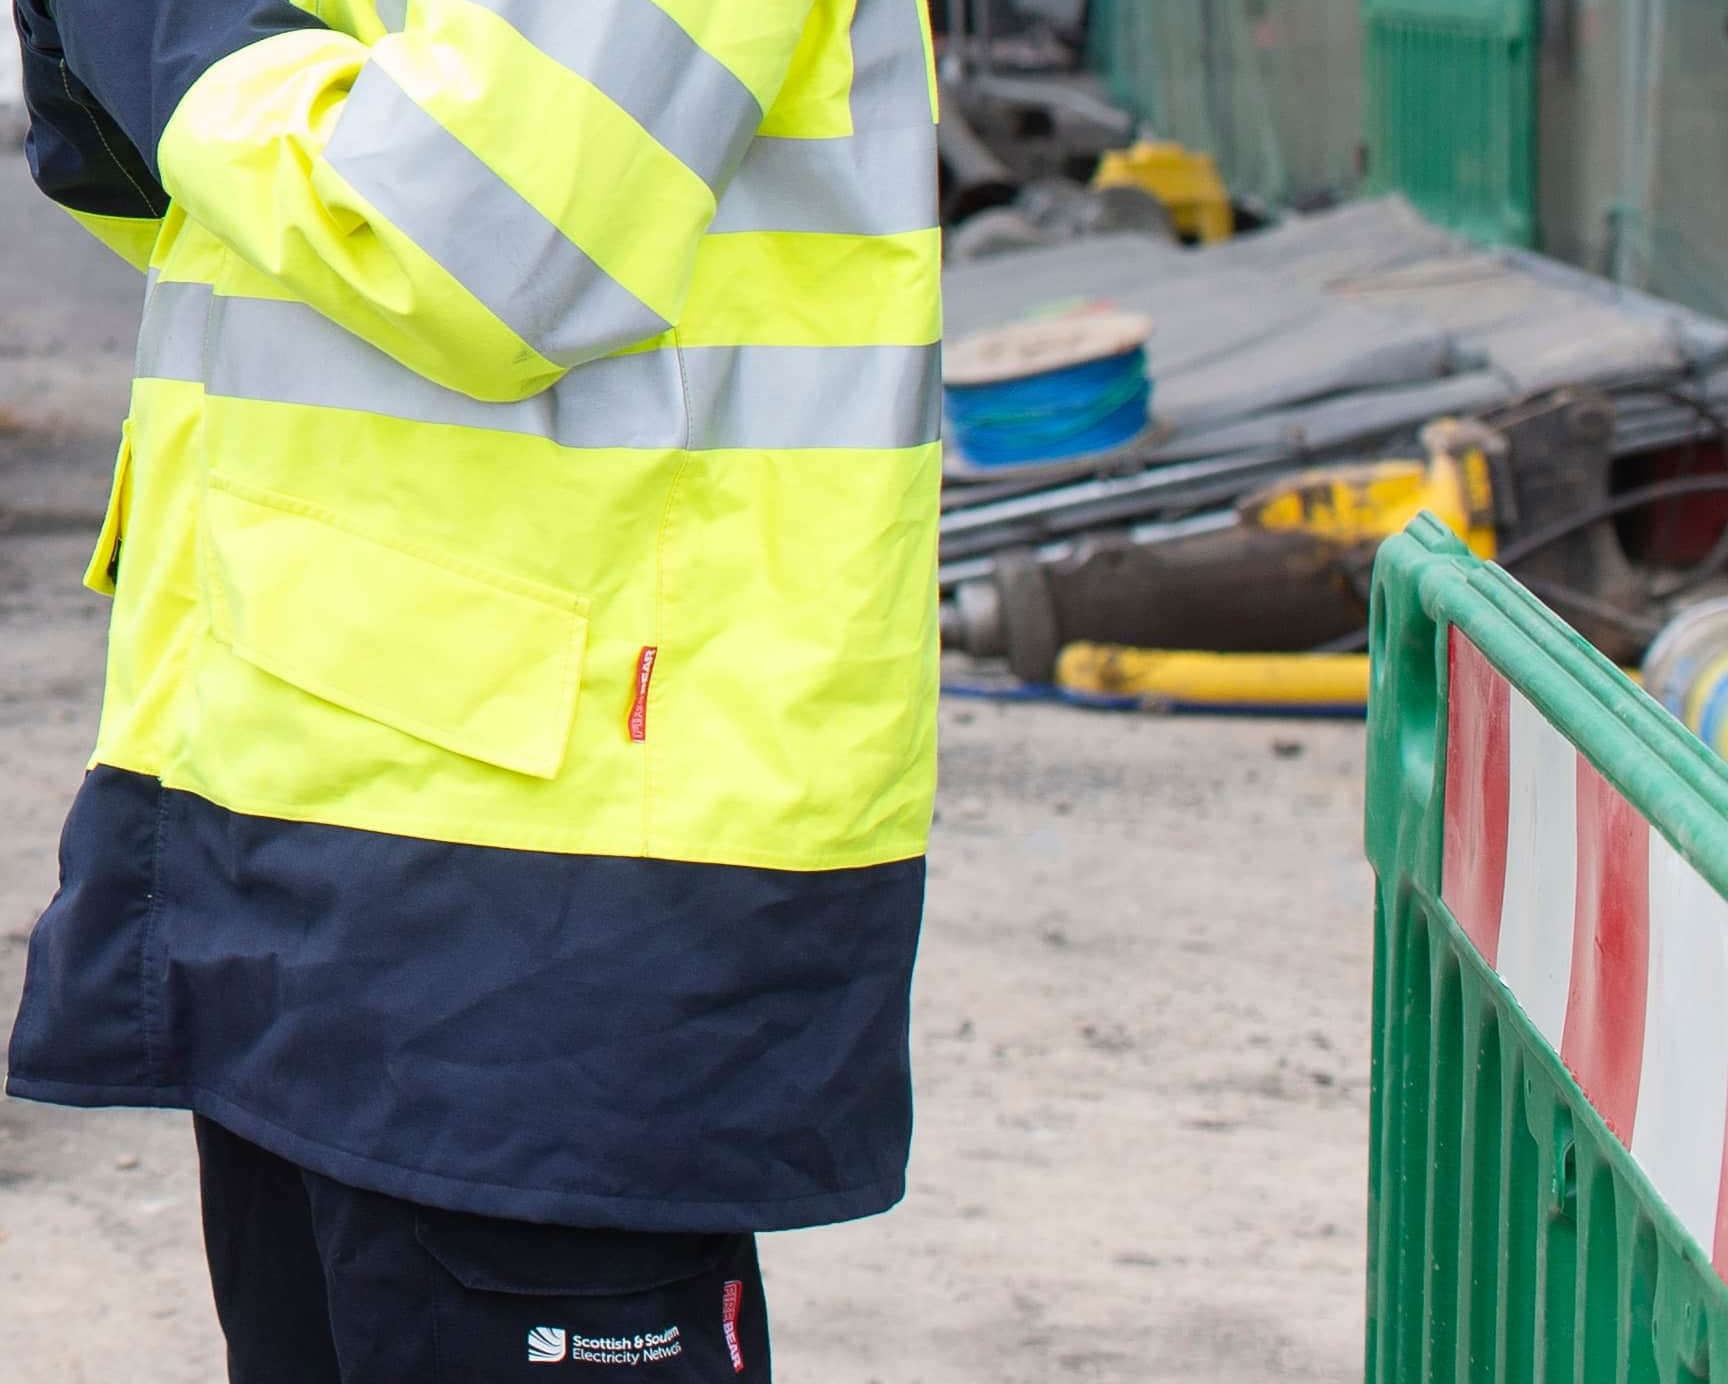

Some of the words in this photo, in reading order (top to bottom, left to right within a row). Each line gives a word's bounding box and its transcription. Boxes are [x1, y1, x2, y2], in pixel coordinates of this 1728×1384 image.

[572, 1335, 632, 1350] Scottish
[633, 1335, 644, 1349] &
[572, 1347, 640, 1366] Electricity
